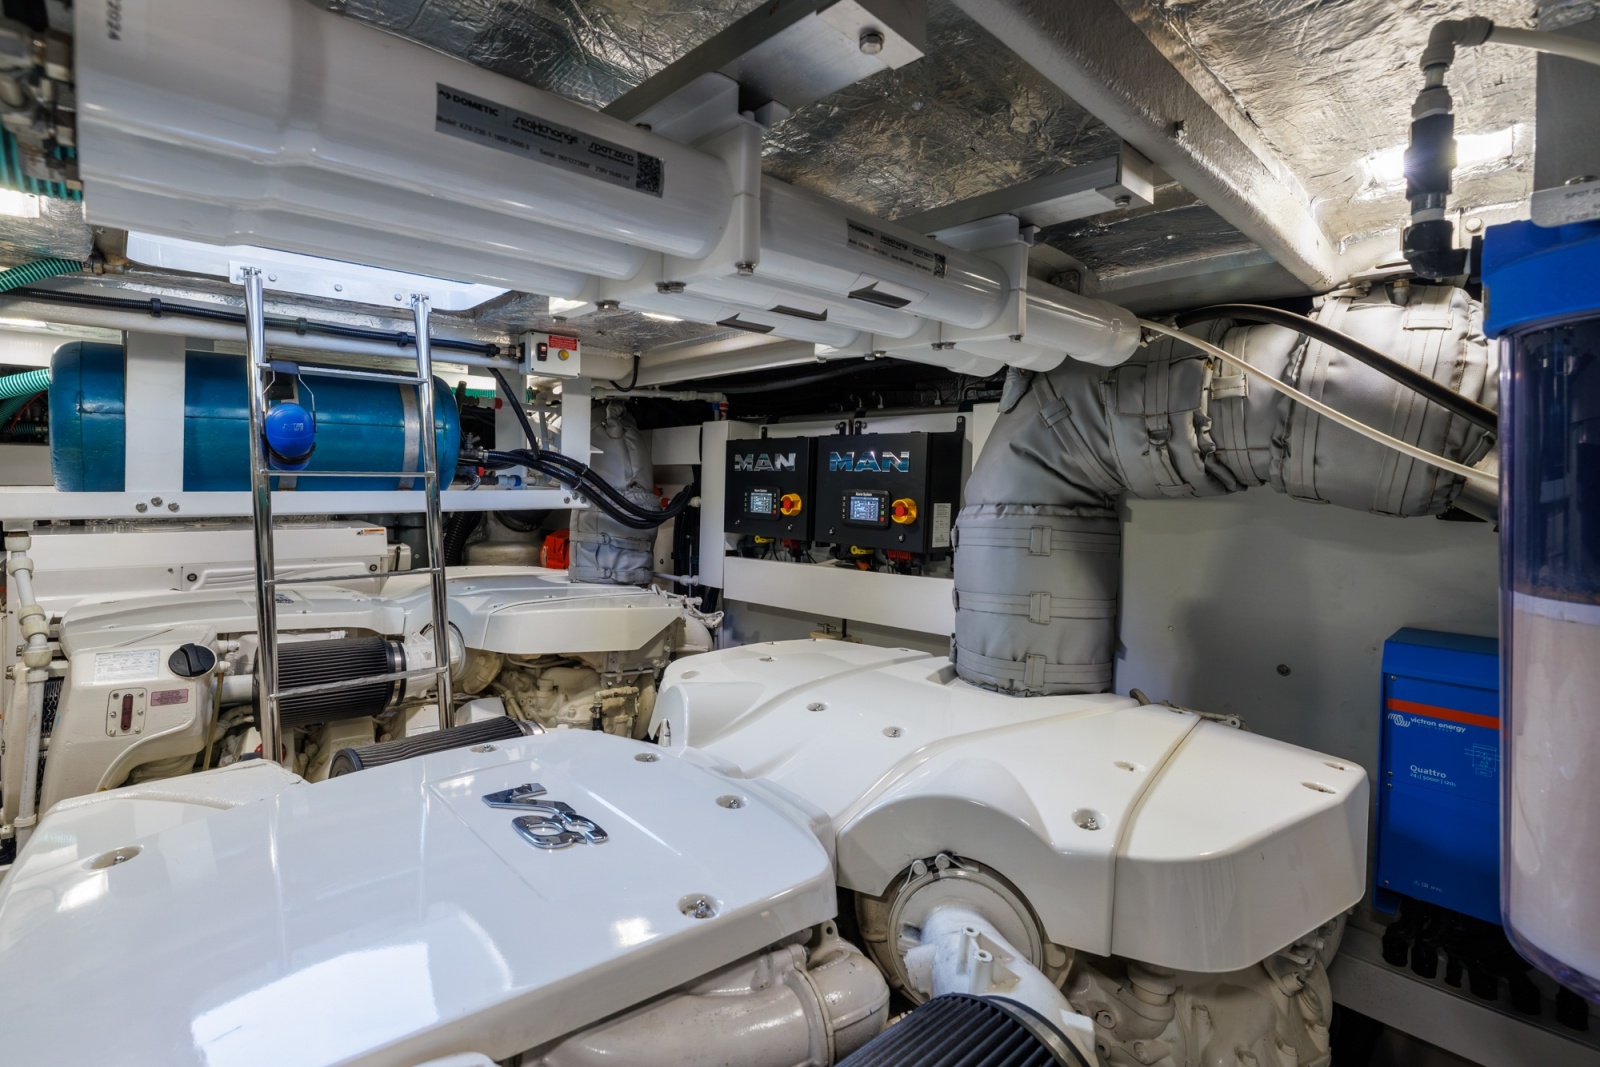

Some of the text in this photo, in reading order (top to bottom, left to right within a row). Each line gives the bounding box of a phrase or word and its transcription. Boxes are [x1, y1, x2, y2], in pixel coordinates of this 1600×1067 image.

[453, 95, 500, 117] DOMETIC
[734, 452, 796, 472] MAN
[829, 450, 910, 473] MAN
[1410, 716, 1466, 734] victron energy
[1409, 764, 1447, 779] Quattro
